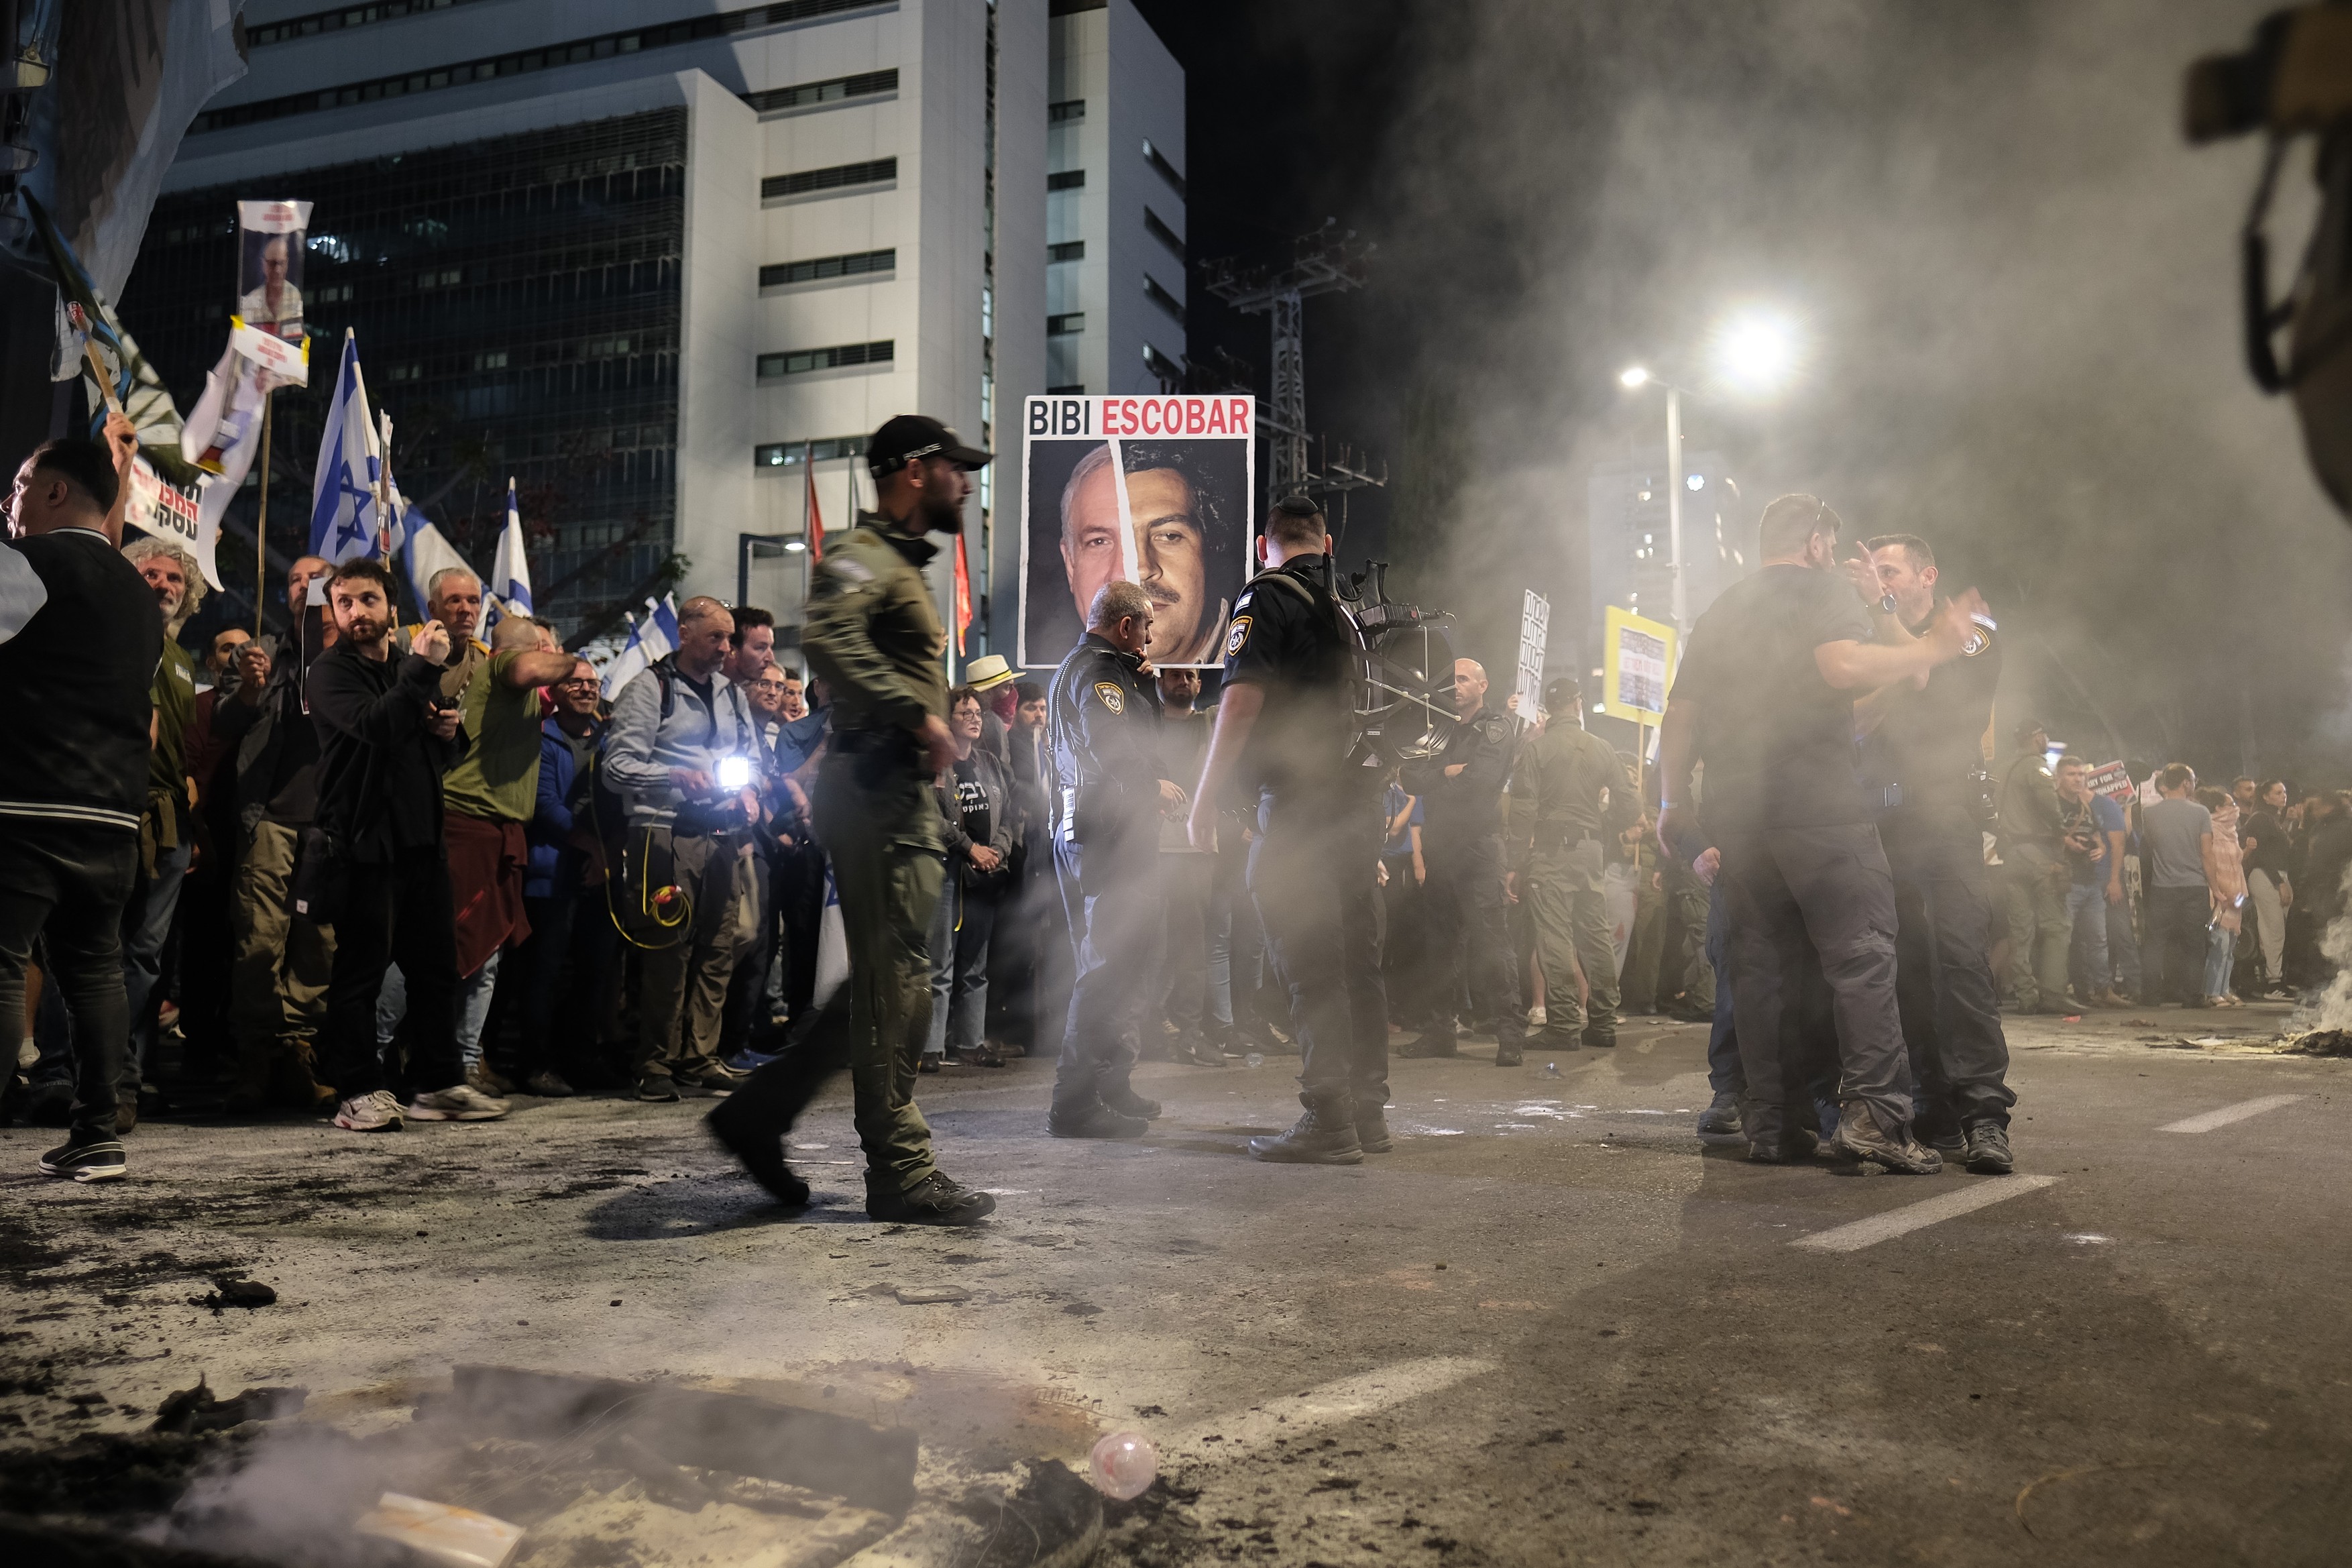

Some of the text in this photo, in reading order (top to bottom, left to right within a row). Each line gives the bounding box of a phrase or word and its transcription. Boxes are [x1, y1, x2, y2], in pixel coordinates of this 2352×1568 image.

[1029, 399, 1248, 435] BIBI ESCOBAR
[2099, 773, 2113, 784] FOR
